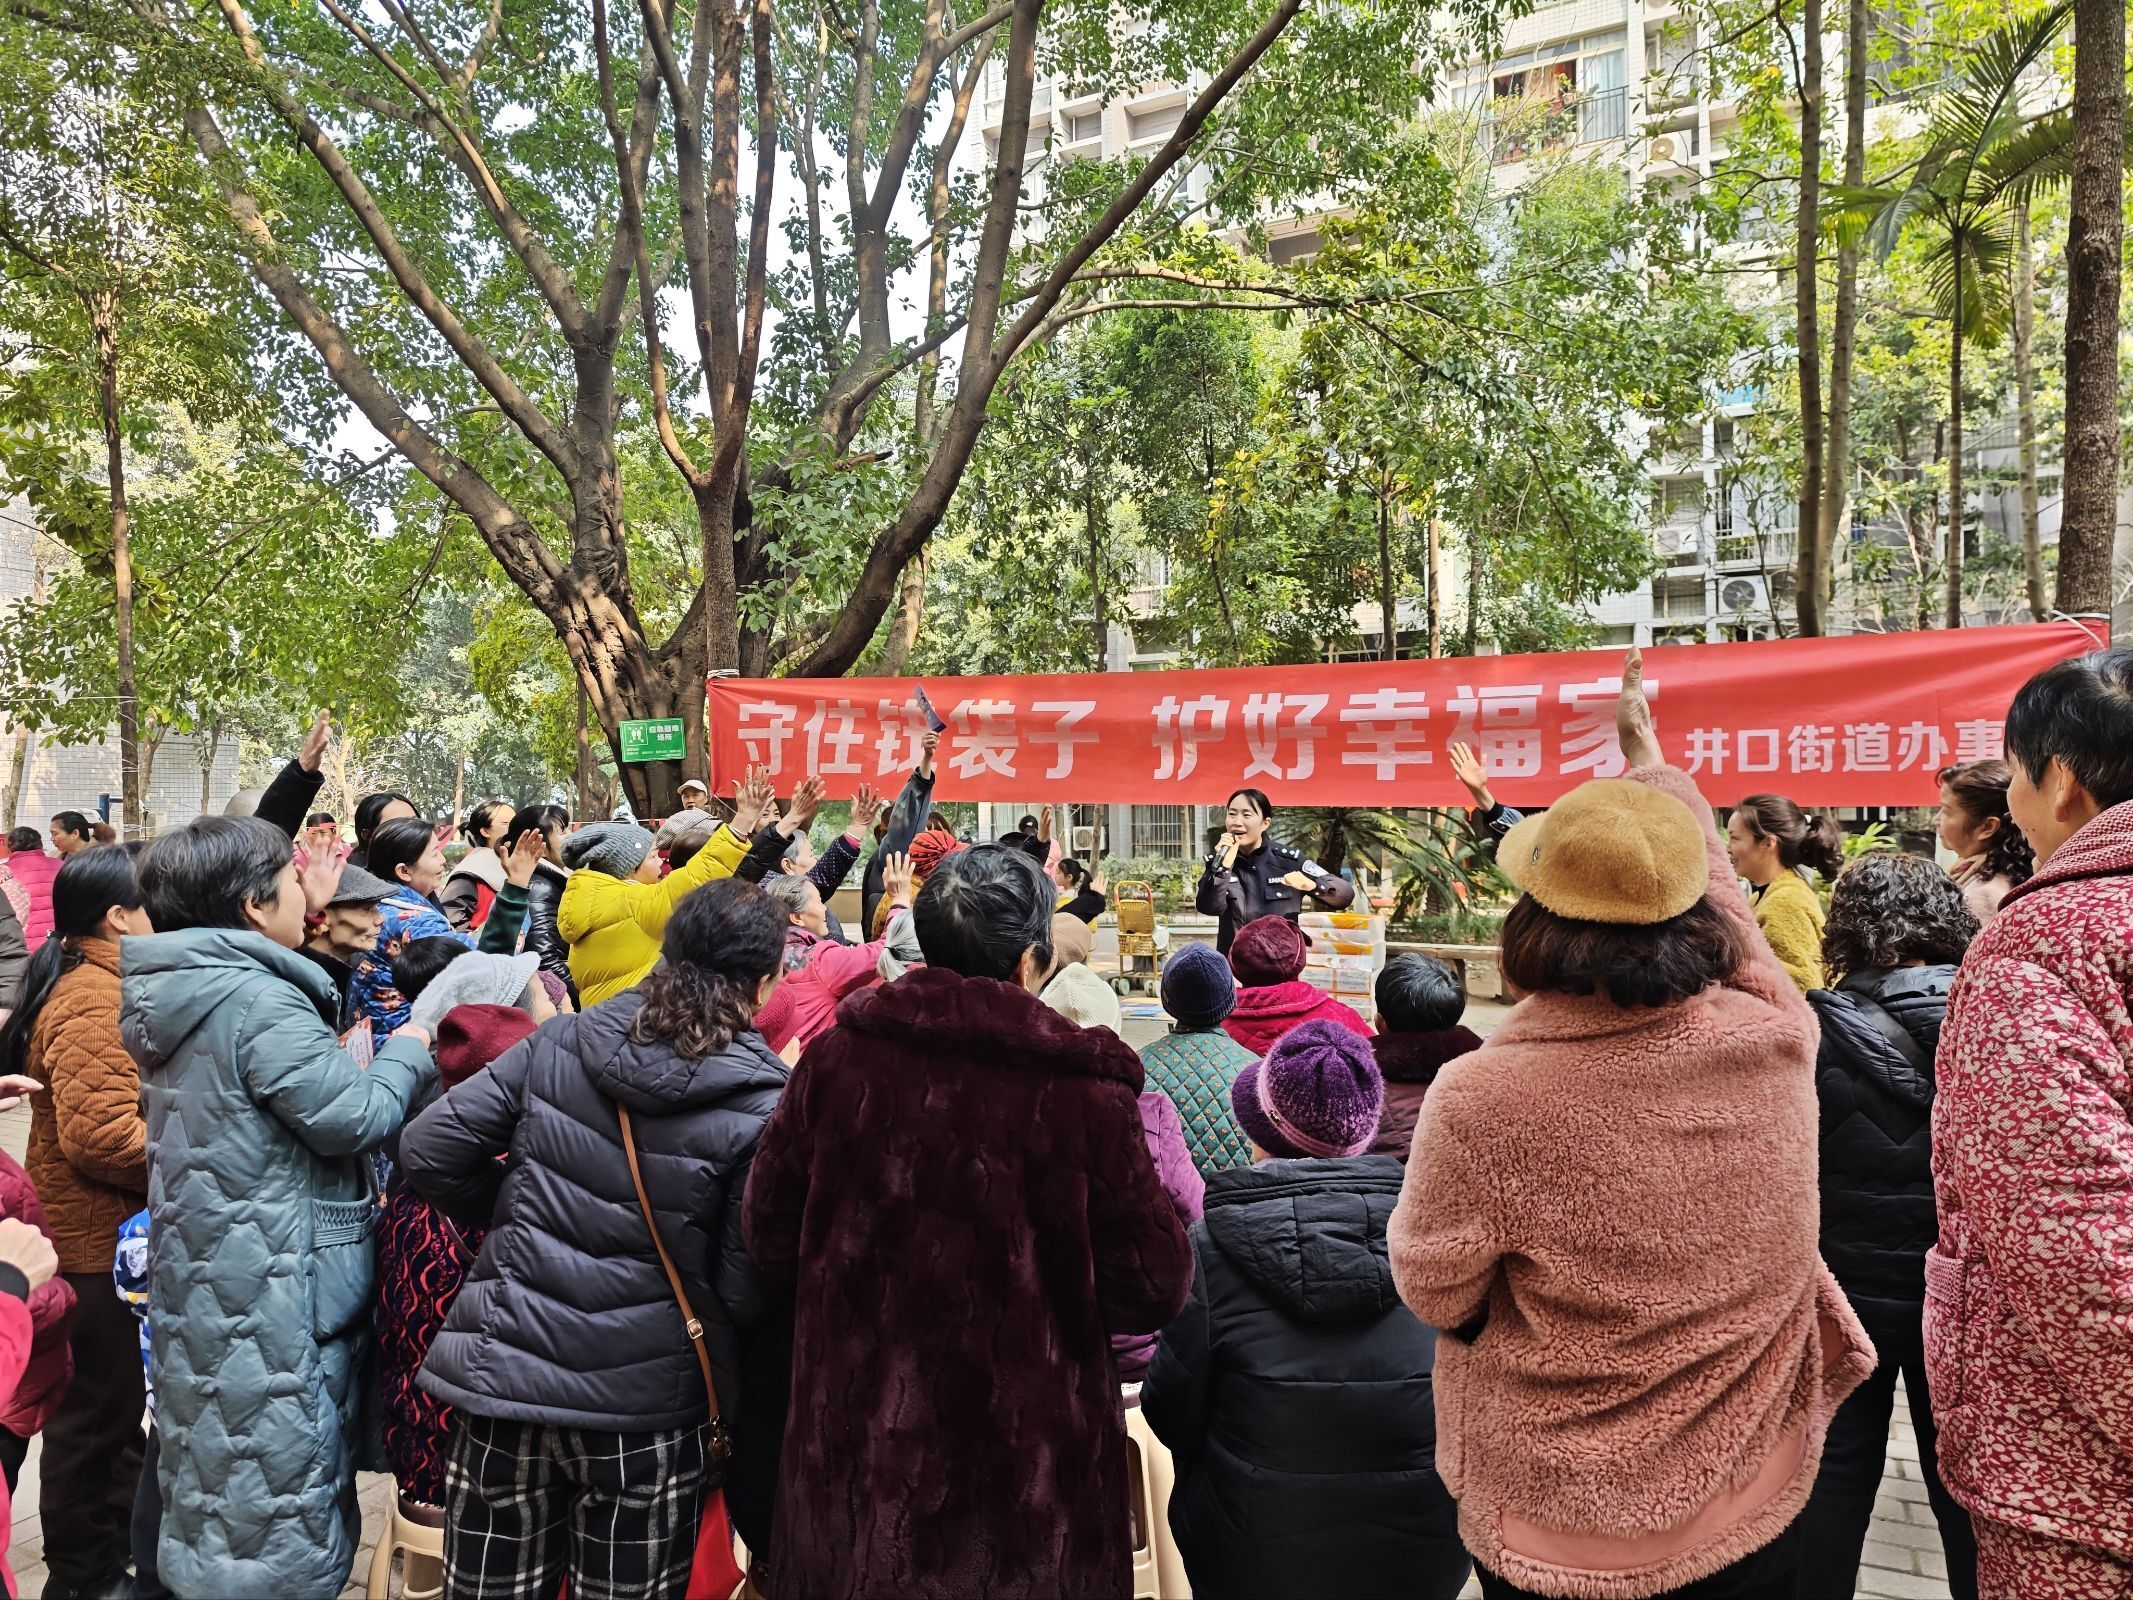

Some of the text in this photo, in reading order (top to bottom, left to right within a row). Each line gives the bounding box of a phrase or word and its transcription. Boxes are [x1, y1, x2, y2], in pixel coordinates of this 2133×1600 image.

[737, 699, 1100, 779] 守住钱袋子
[1151, 677, 1659, 781] 护好幸福家
